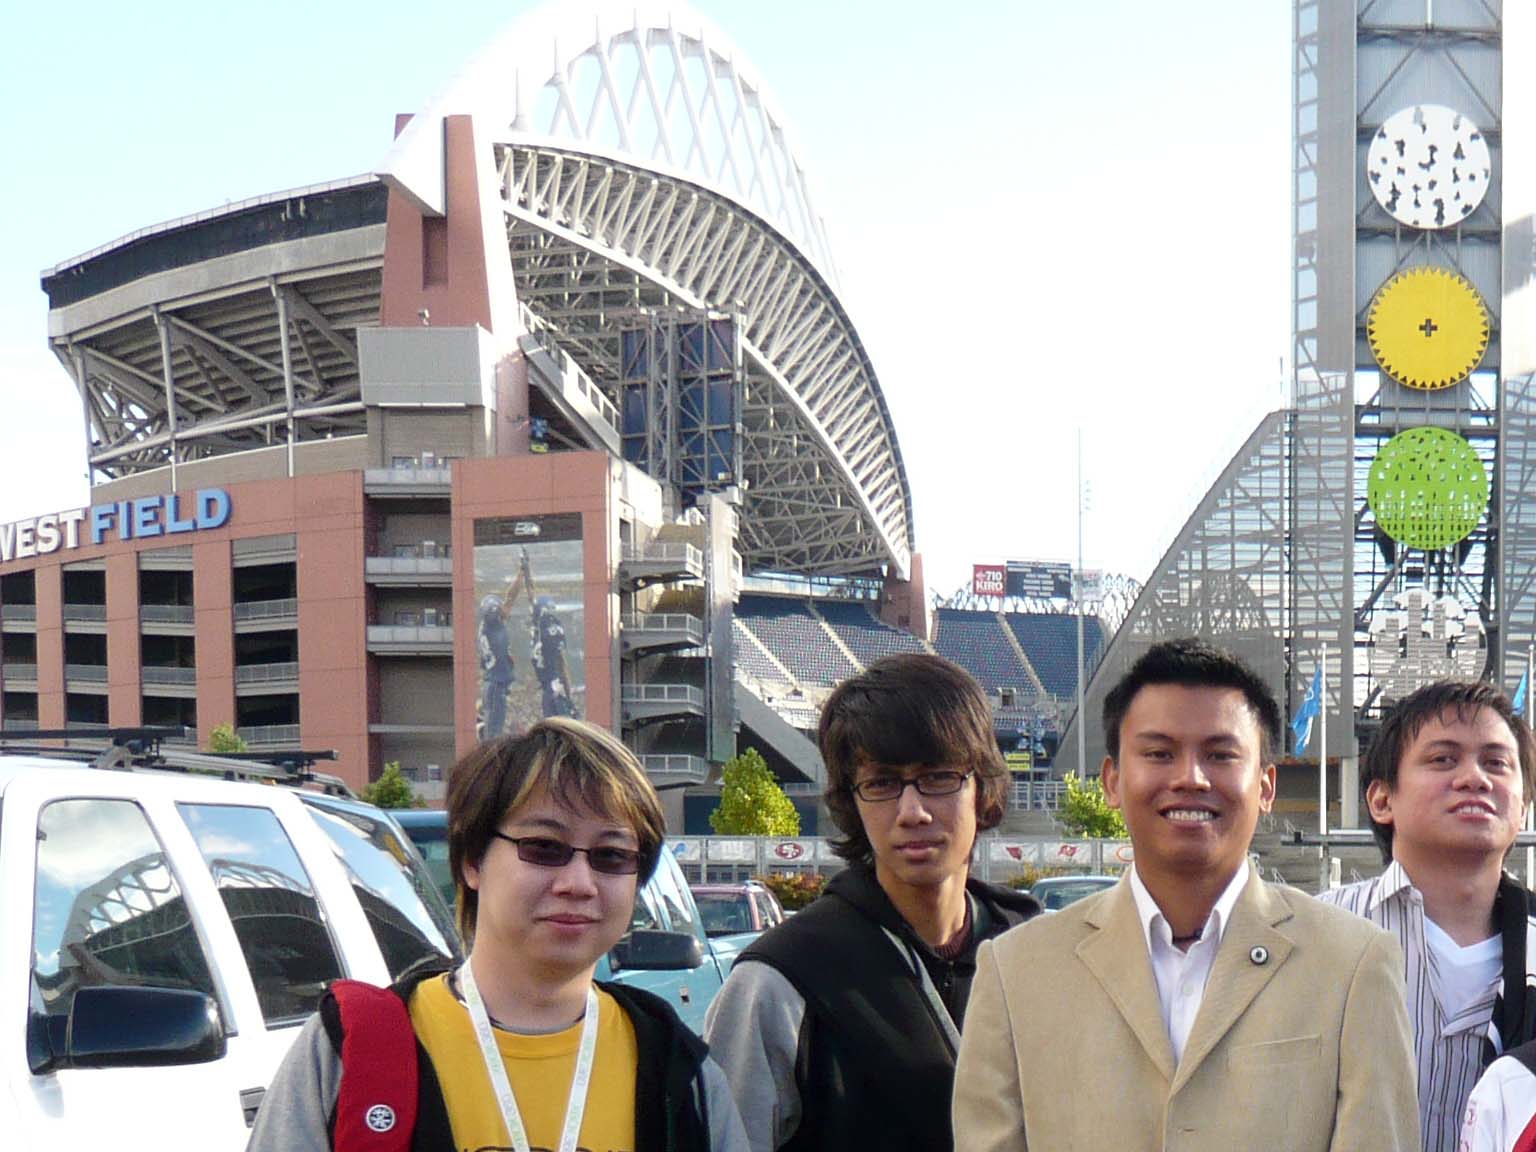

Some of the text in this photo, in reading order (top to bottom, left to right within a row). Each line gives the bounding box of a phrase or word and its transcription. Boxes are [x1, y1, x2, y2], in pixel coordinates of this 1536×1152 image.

[92, 488, 231, 544] FIELD
[985, 571, 1002, 581] 710
[976, 580, 1003, 590] KIRO
